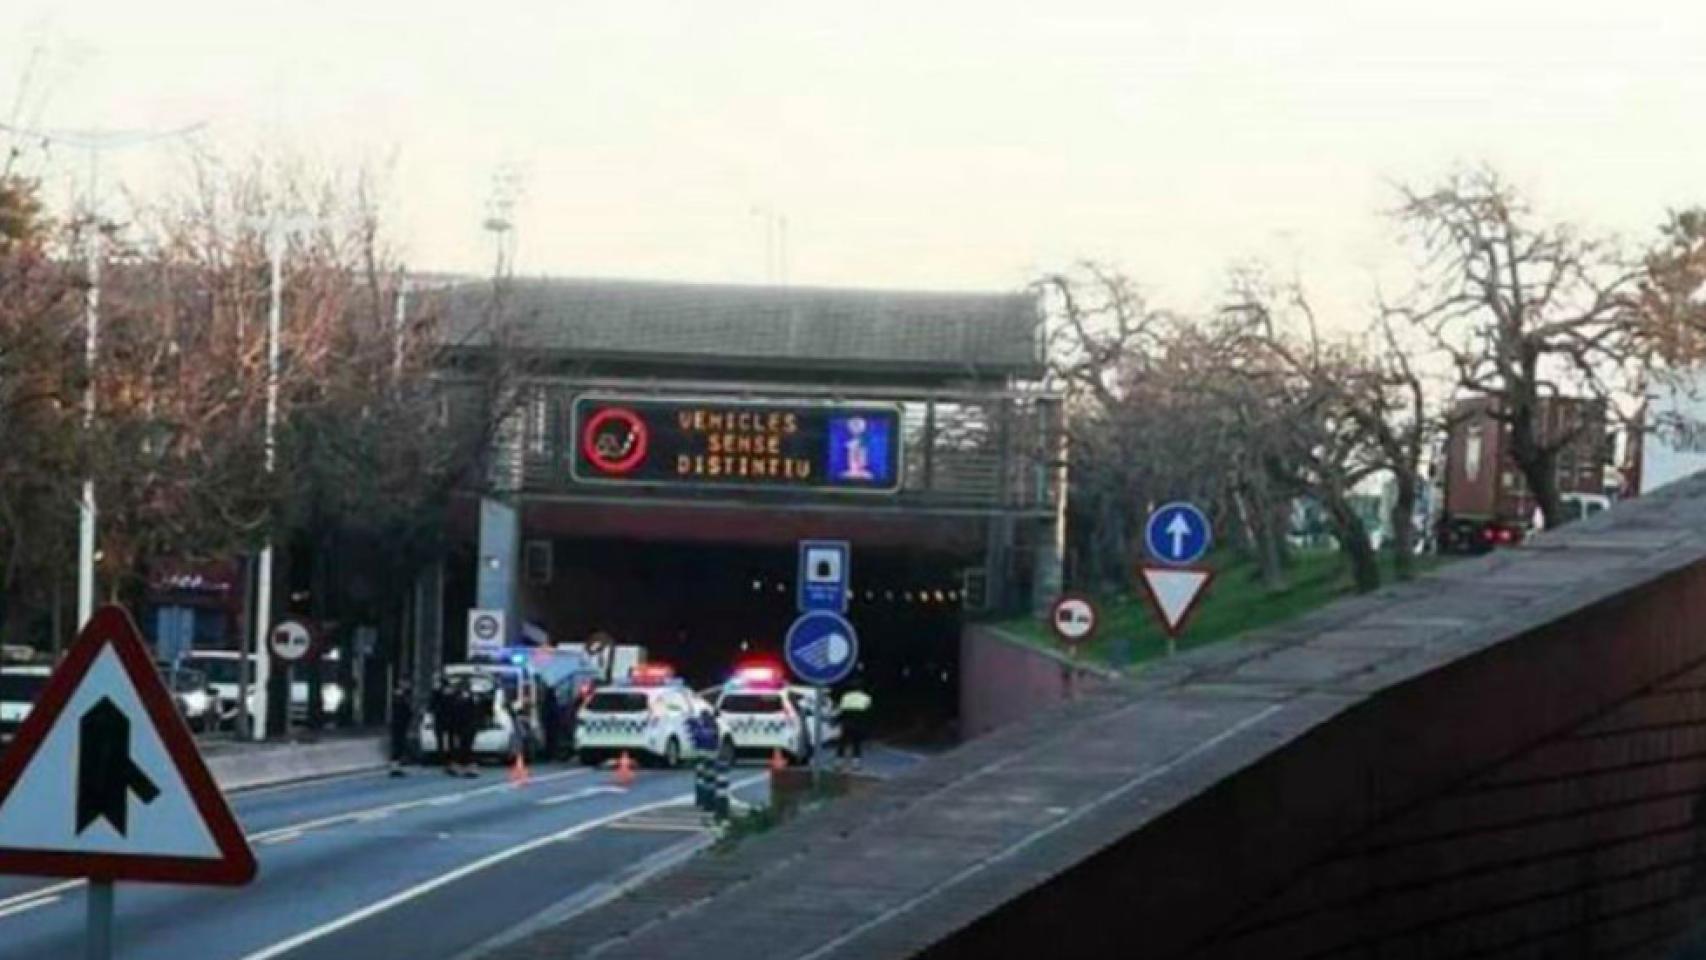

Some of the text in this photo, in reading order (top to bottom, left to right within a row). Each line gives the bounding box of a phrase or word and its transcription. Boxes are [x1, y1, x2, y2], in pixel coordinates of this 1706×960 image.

[678, 410, 797, 433] VEHICLES
[708, 433, 780, 454] SENSE
[677, 455, 811, 478] DISTINTIU
